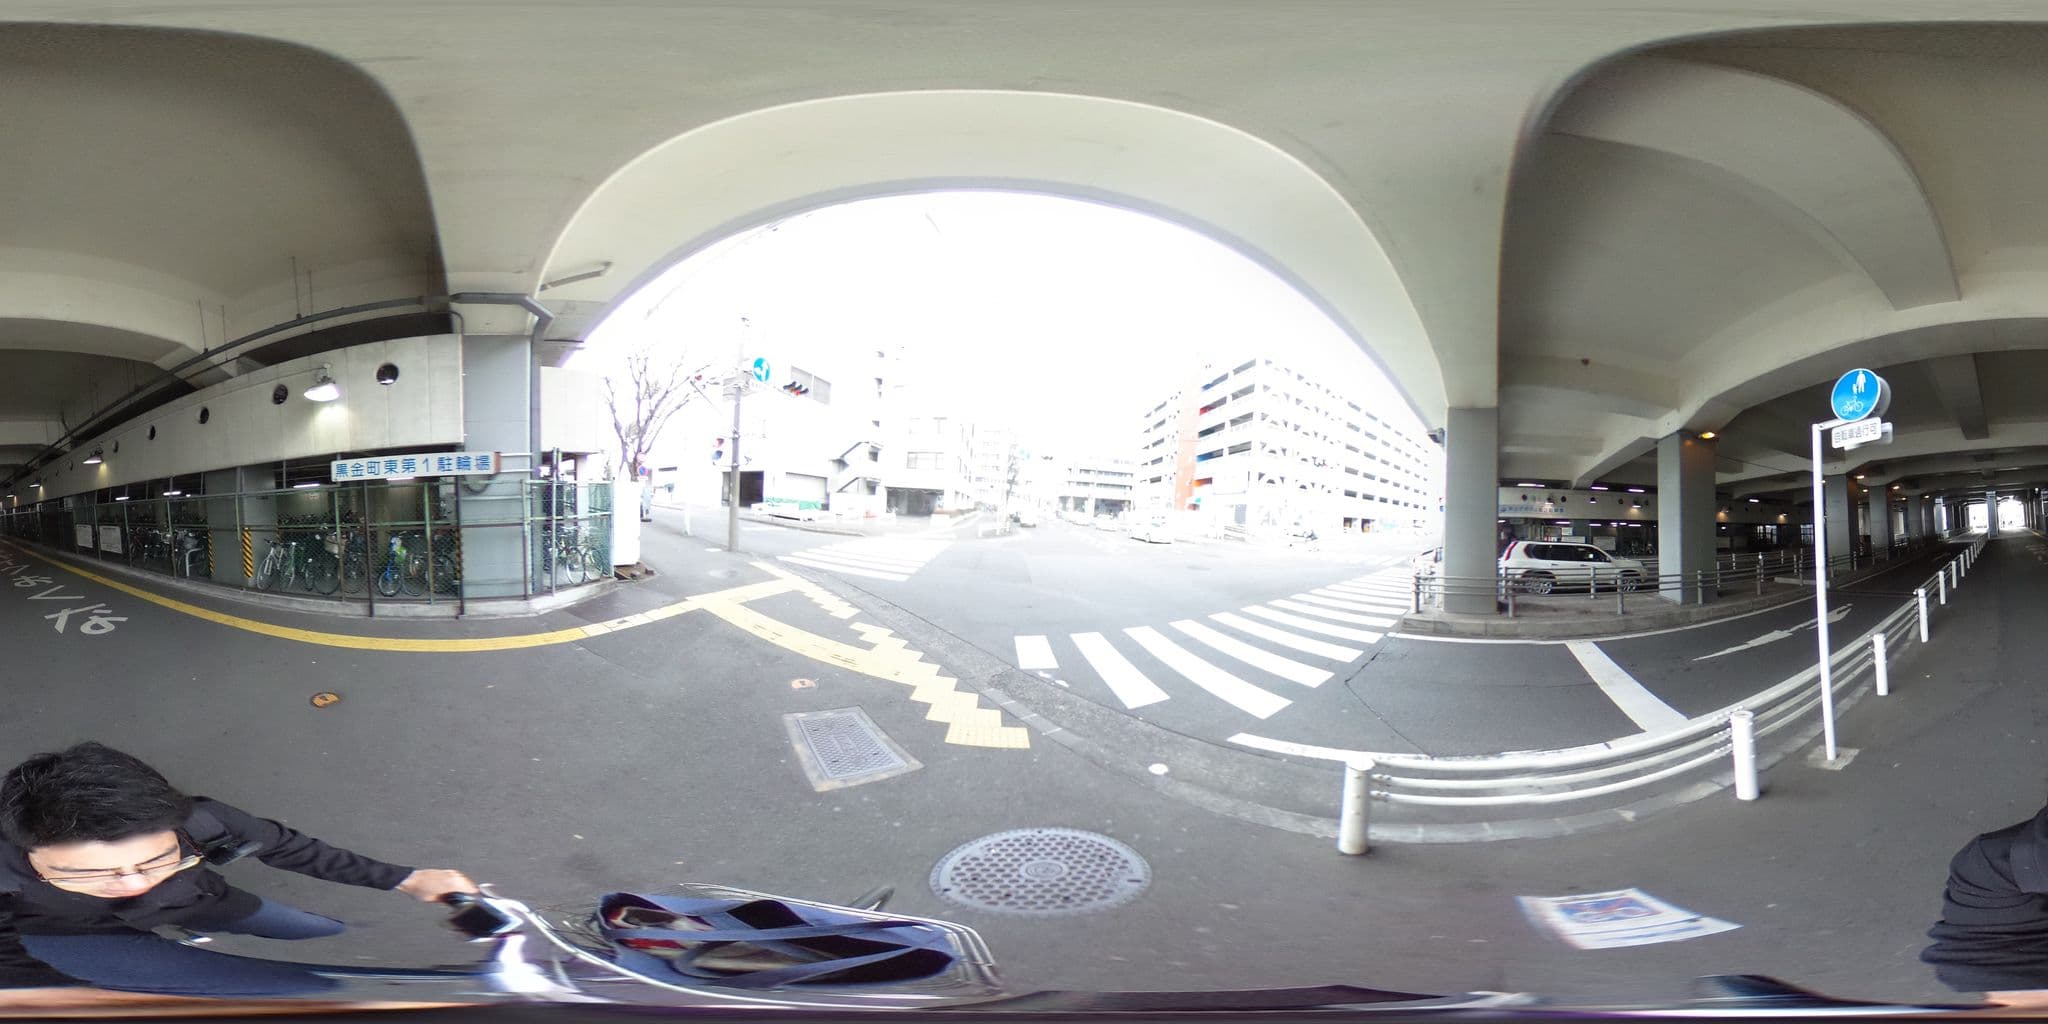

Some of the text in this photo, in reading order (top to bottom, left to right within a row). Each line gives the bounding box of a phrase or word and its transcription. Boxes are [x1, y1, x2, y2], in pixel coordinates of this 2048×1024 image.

[335, 455, 490, 477] 黒金町東第1駐輪場
